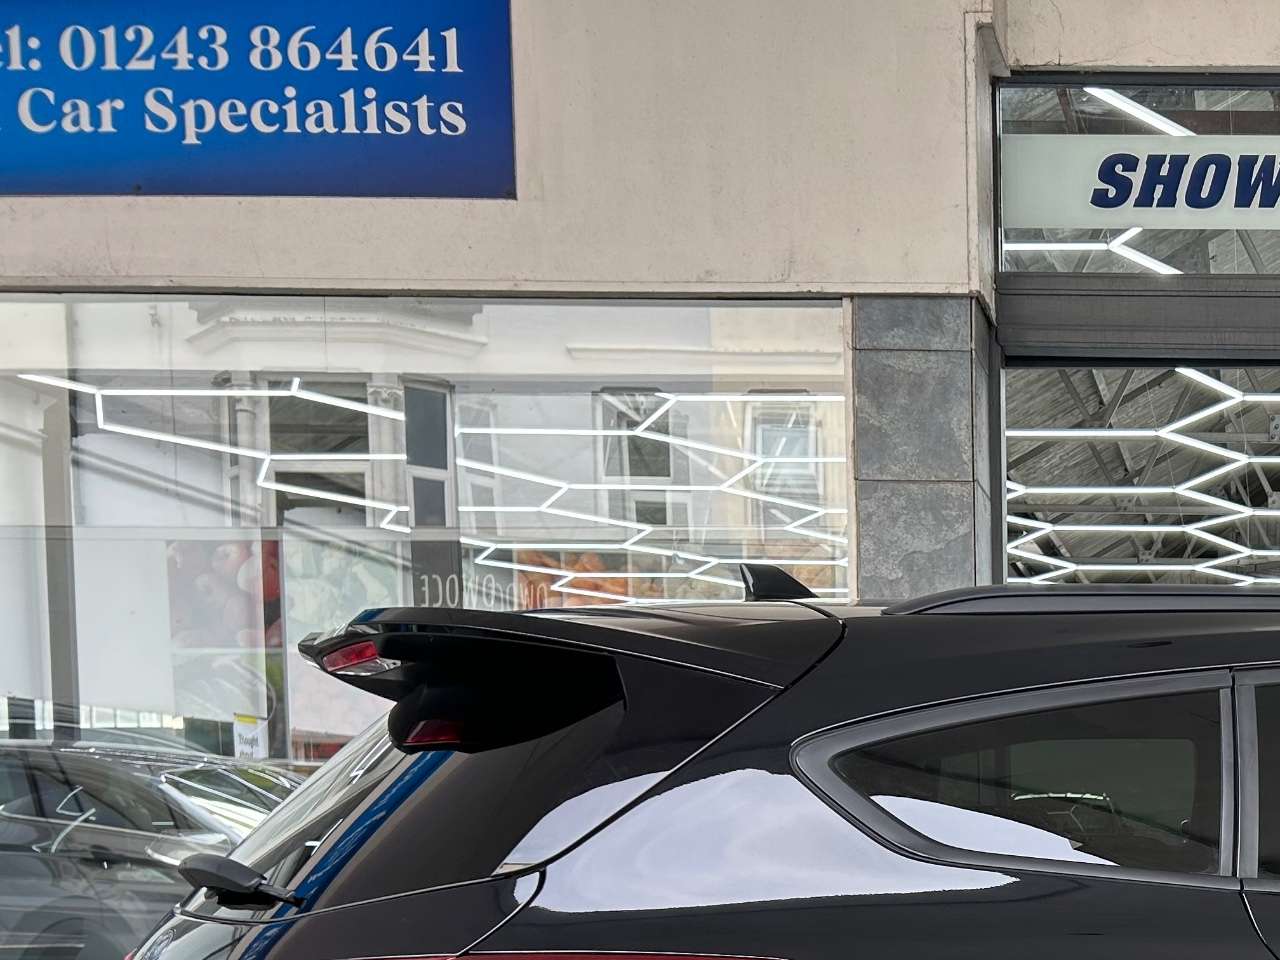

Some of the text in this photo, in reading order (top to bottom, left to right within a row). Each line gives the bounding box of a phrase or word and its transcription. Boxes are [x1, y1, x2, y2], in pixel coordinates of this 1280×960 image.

[0, 25, 464, 72] l: 01243 864641
[18, 86, 467, 144] Car Specialists
